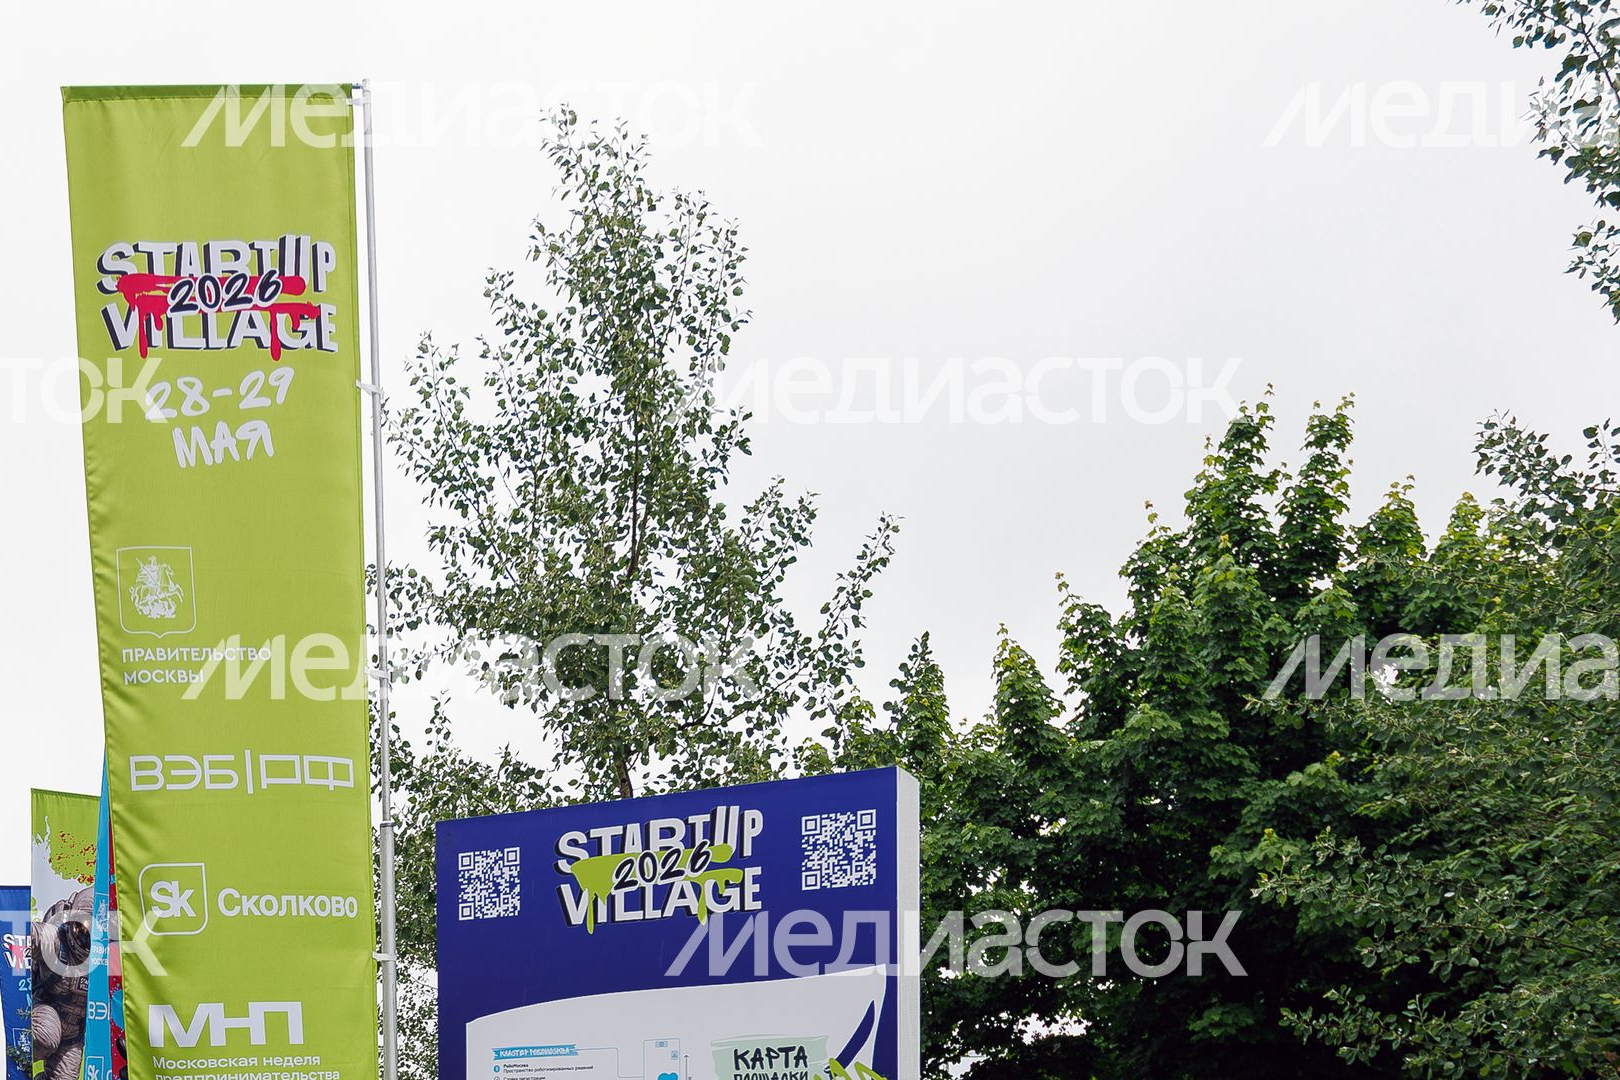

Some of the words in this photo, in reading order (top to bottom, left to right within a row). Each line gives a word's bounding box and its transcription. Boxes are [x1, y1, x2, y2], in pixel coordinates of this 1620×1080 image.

[95, 233, 337, 296] STARTUP
[167, 268, 284, 316] 2026
[101, 301, 338, 353] VILLAGE
[144, 366, 295, 422] 28-29
[172, 421, 275, 469] МАЯ
[122, 646, 272, 664] ПРАВИТЕЛЬСТВО
[123, 669, 204, 685] МОСКВЫ
[554, 805, 764, 875] STARTUP
[610, 841, 713, 892] 2026
[151, 879, 197, 919] Sk
[217, 888, 358, 919] Сколково
[556, 866, 763, 927] VILLAGE
[148, 1001, 304, 1048] МНП
[152, 1055, 257, 1070] Московская
[262, 1053, 321, 1067] неделя
[733, 1046, 808, 1070] КАРТА
